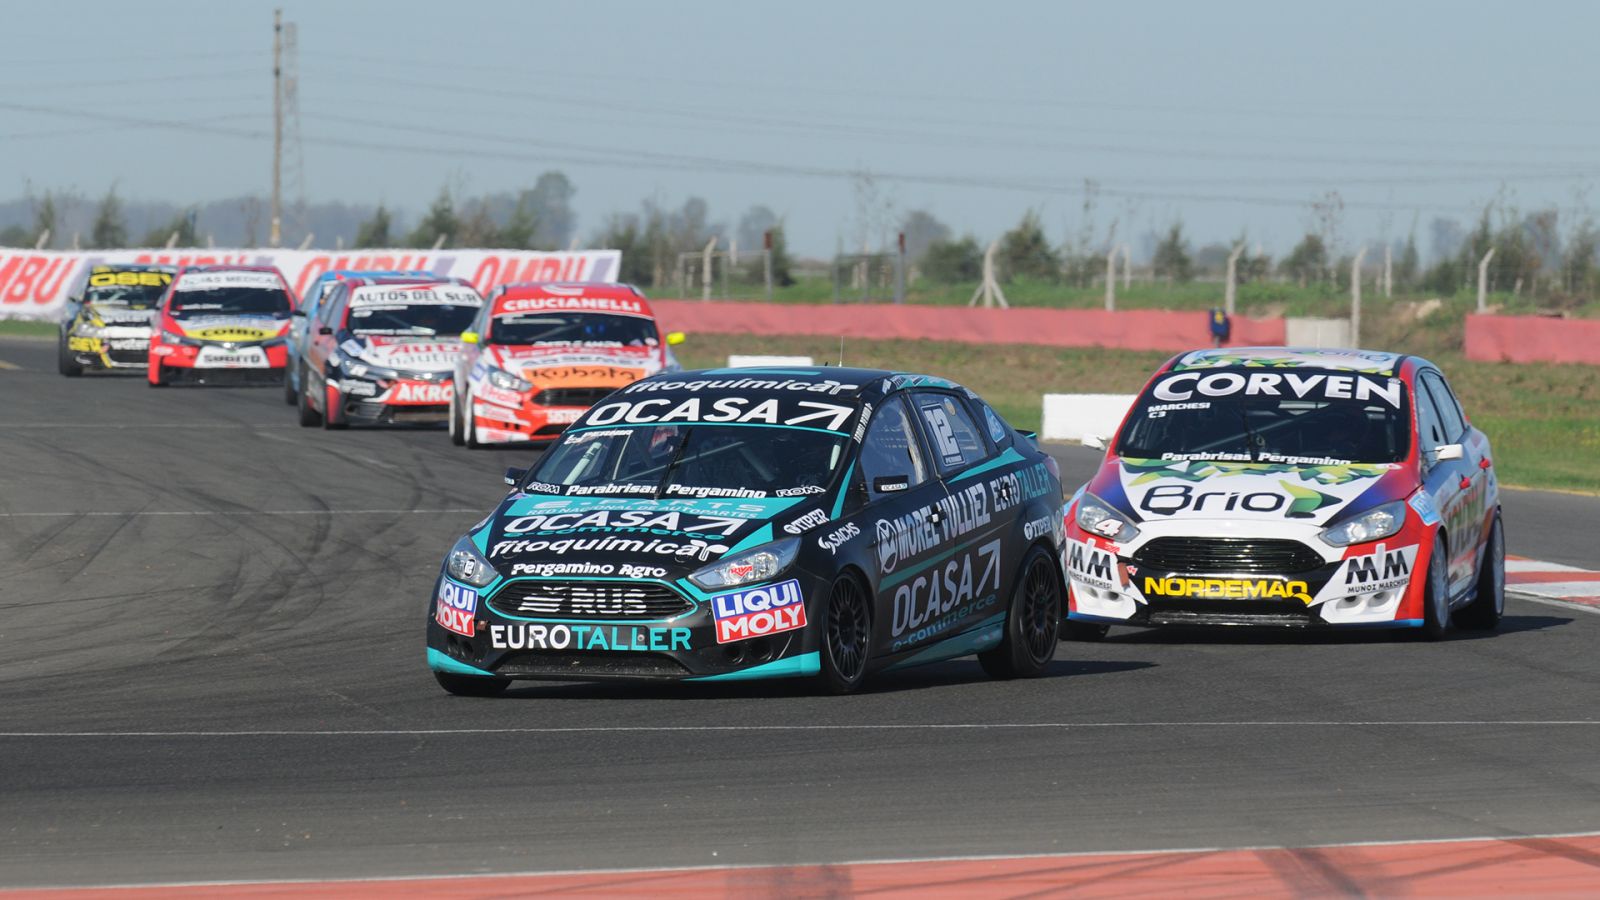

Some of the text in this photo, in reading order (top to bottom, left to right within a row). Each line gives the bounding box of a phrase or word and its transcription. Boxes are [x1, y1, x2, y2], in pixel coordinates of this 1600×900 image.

[356, 290, 478, 303] AUTOS DEL SUR
[503, 298, 641, 312] CRUCIANELLI
[531, 367, 636, 381] Kubota
[1153, 372, 1400, 409] CORVEN
[586, 397, 778, 426] OCASA
[1148, 402, 1210, 412] MARCHESI
[923, 408, 960, 456] 12
[1161, 451, 1251, 461] Parabrisas
[665, 484, 767, 498] Pergamino
[504, 511, 680, 533] OCASA
[667, 506, 758, 519] AUTOPARTES
[504, 526, 725, 540] e-commerce
[829, 521, 861, 547] SACHS
[511, 562, 668, 578] Pergamino Agro
[716, 582, 799, 618] LIQUI
[892, 554, 974, 638] OCASA
[1144, 577, 1313, 606] NORDEMAQ
[721, 604, 802, 641] MOLY
[490, 625, 692, 651] EUROTALLER
